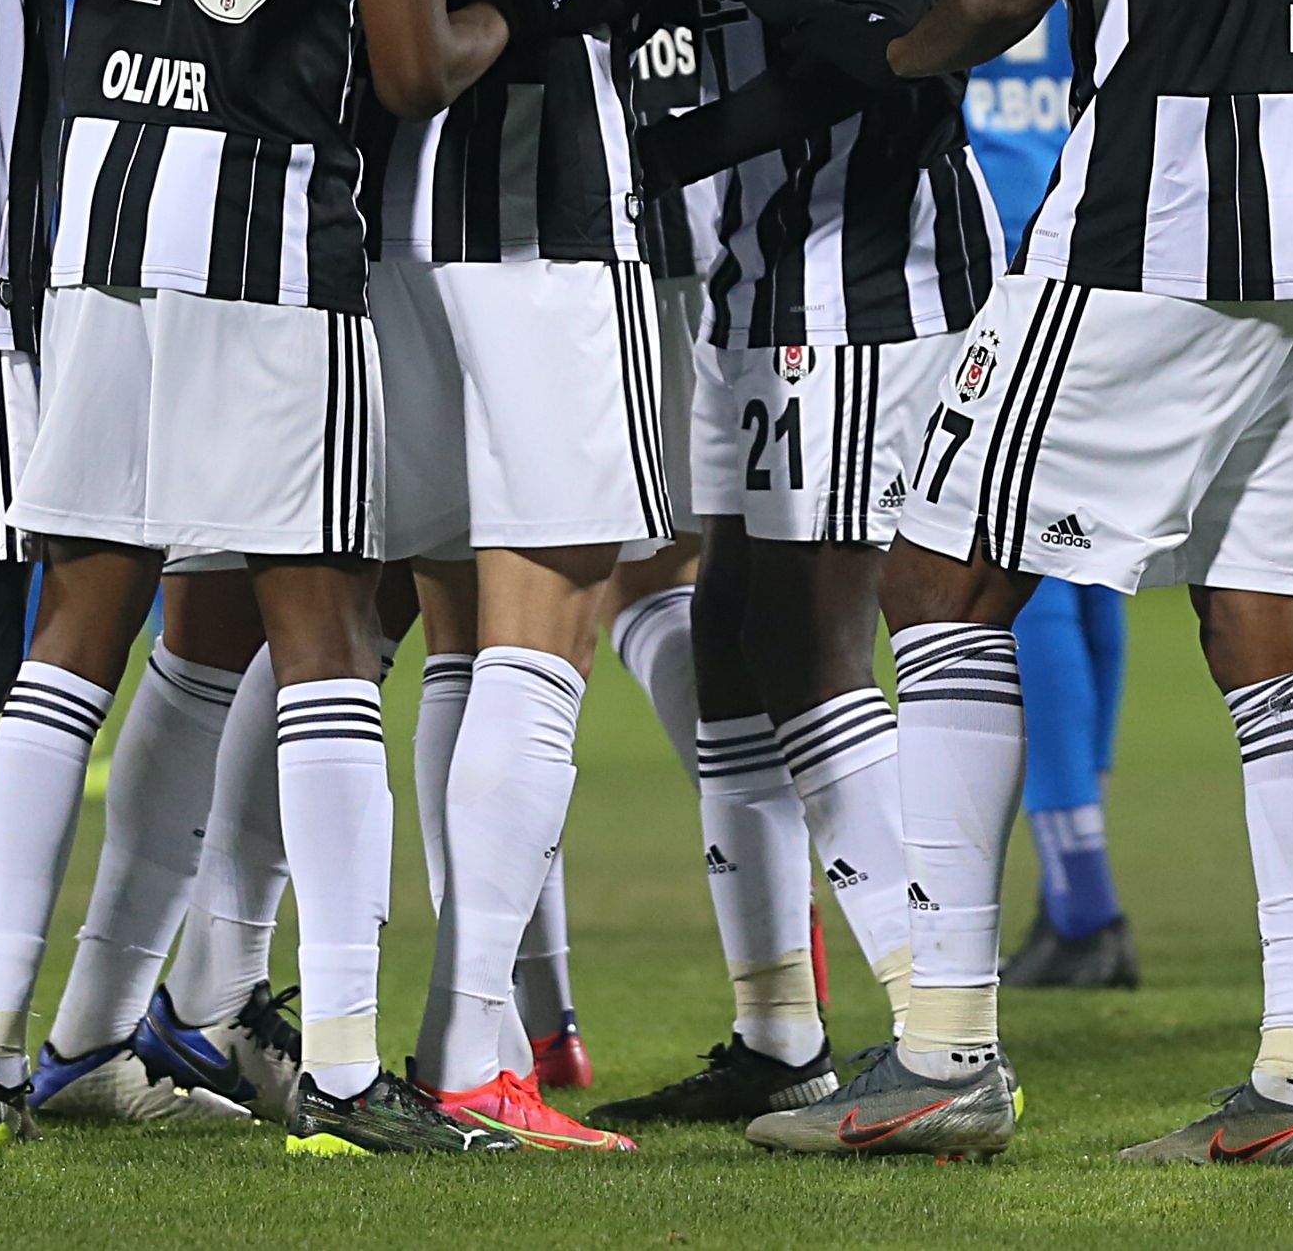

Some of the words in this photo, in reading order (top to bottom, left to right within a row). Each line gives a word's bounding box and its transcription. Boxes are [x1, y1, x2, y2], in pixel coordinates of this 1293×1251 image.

[102, 49, 209, 122] OLIVER
[741, 397, 804, 491] 21
[912, 401, 975, 505] 17
[1040, 532, 1092, 550] adidas
